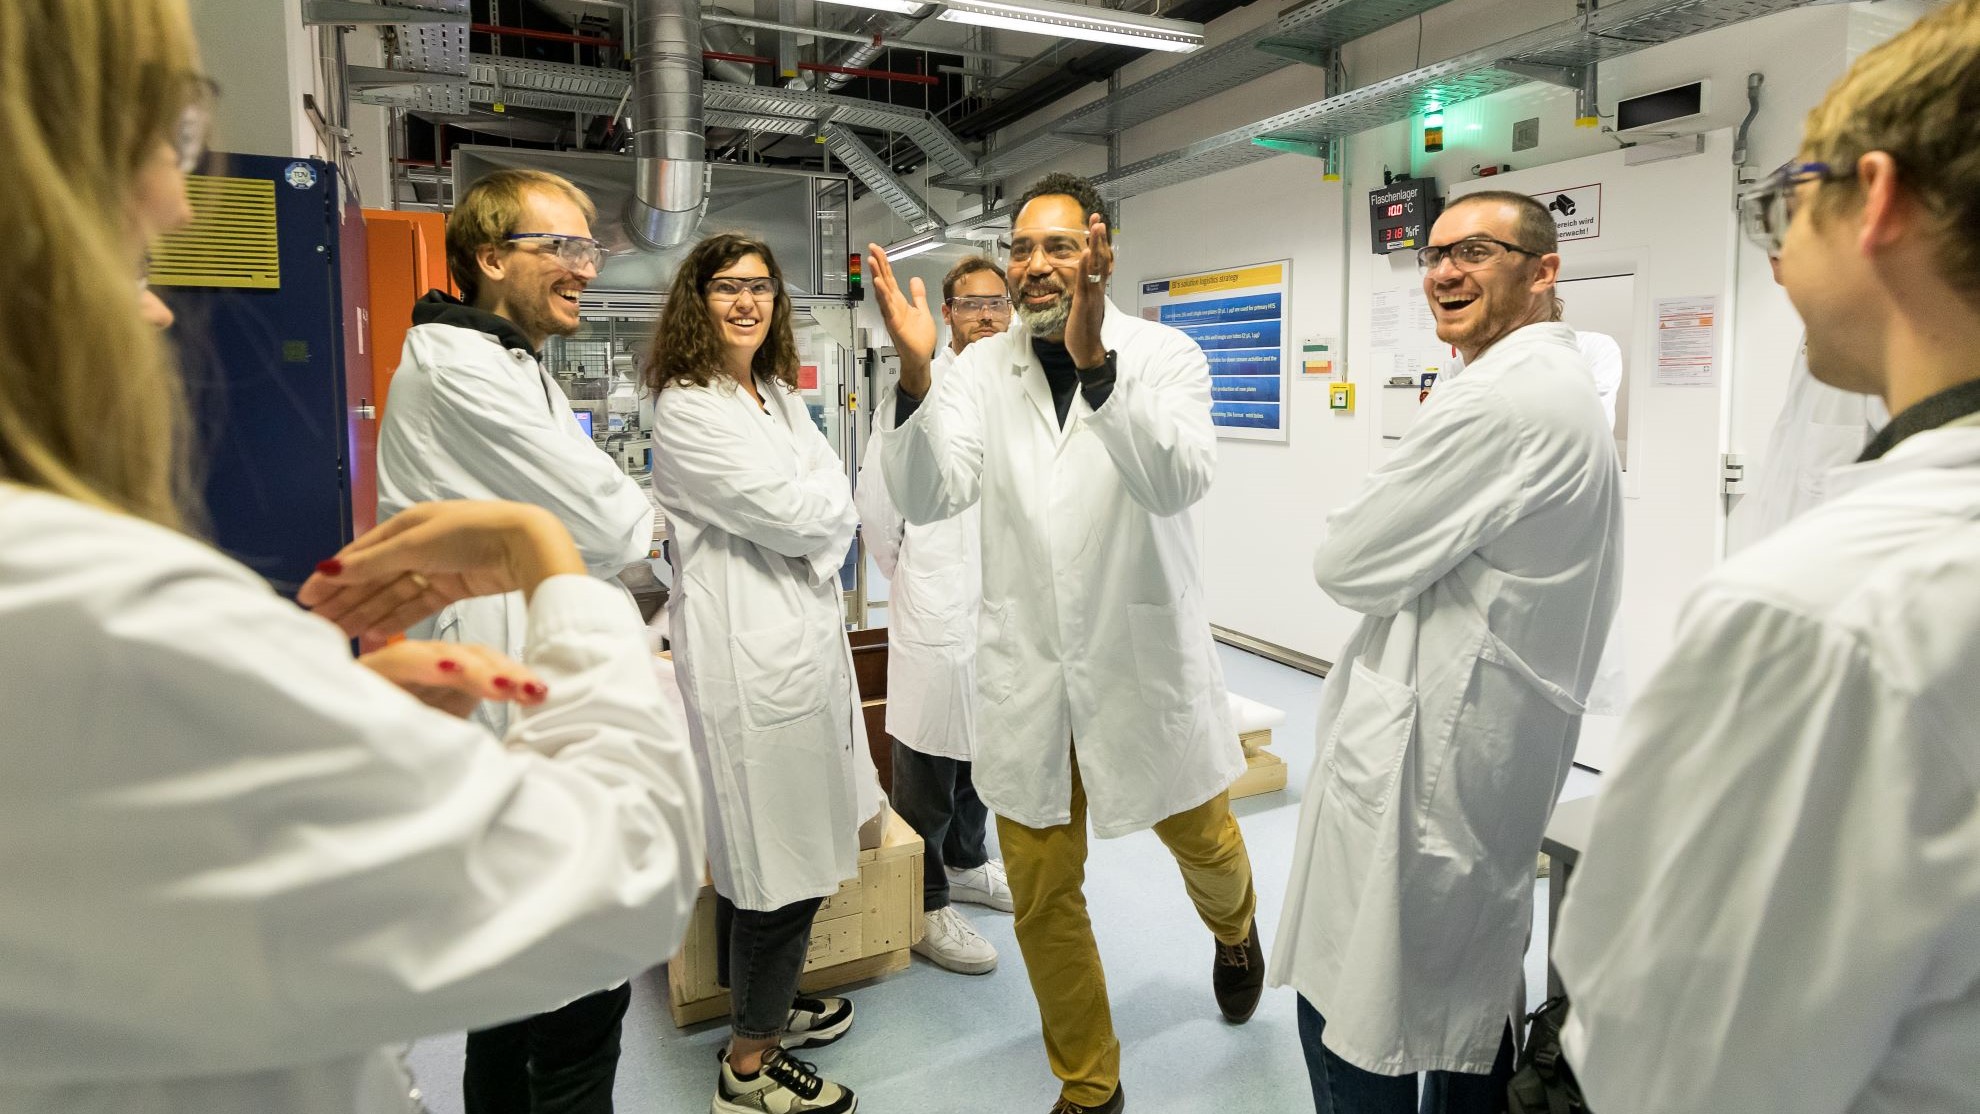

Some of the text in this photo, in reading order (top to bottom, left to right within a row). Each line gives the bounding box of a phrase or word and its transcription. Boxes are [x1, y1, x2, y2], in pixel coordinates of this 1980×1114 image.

[1371, 189, 1418, 205] Flaschenlager
[1557, 217, 1594, 228] ereich wird
[1560, 228, 1588, 237] erwacht!
[1181, 279, 1199, 288] solution
[1200, 277, 1219, 286] logistics
[1219, 274, 1239, 283] strategy
